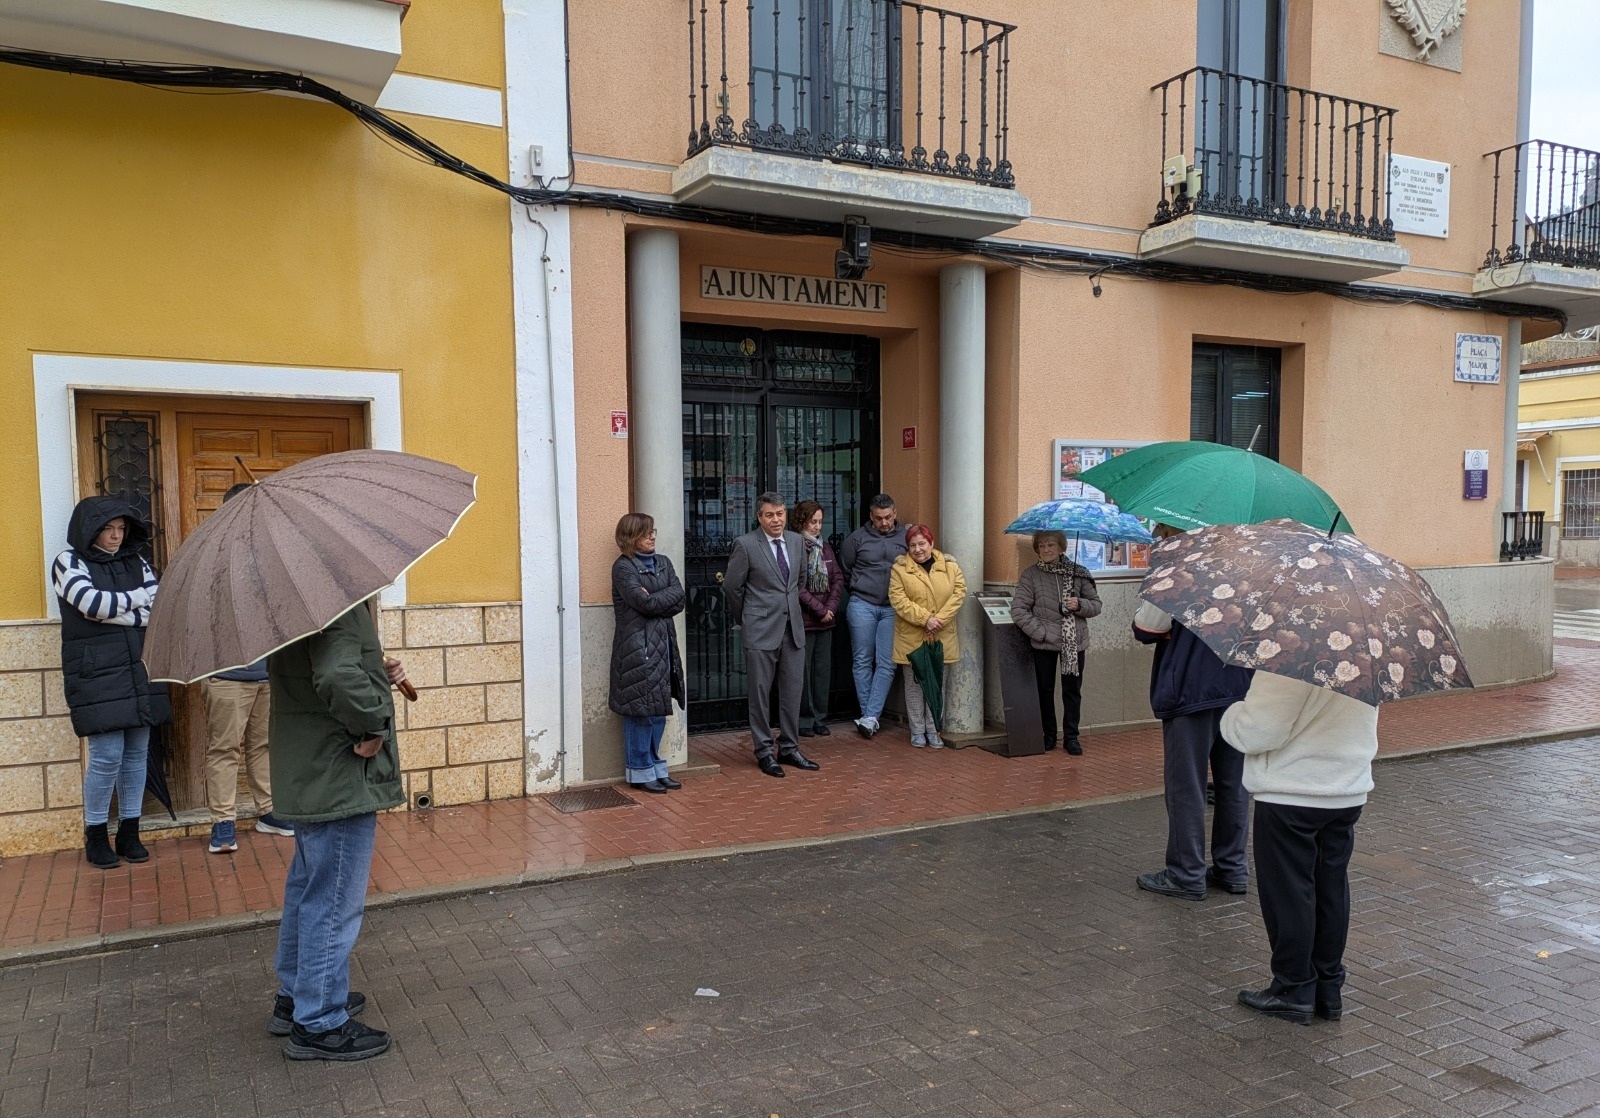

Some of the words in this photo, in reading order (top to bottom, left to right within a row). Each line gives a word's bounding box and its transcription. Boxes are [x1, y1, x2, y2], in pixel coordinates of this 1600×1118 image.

[704, 268, 886, 309] AJUNTAMENT
[1470, 347, 1488, 357] PLAÇA
[1468, 360, 1488, 370] MAJOR
